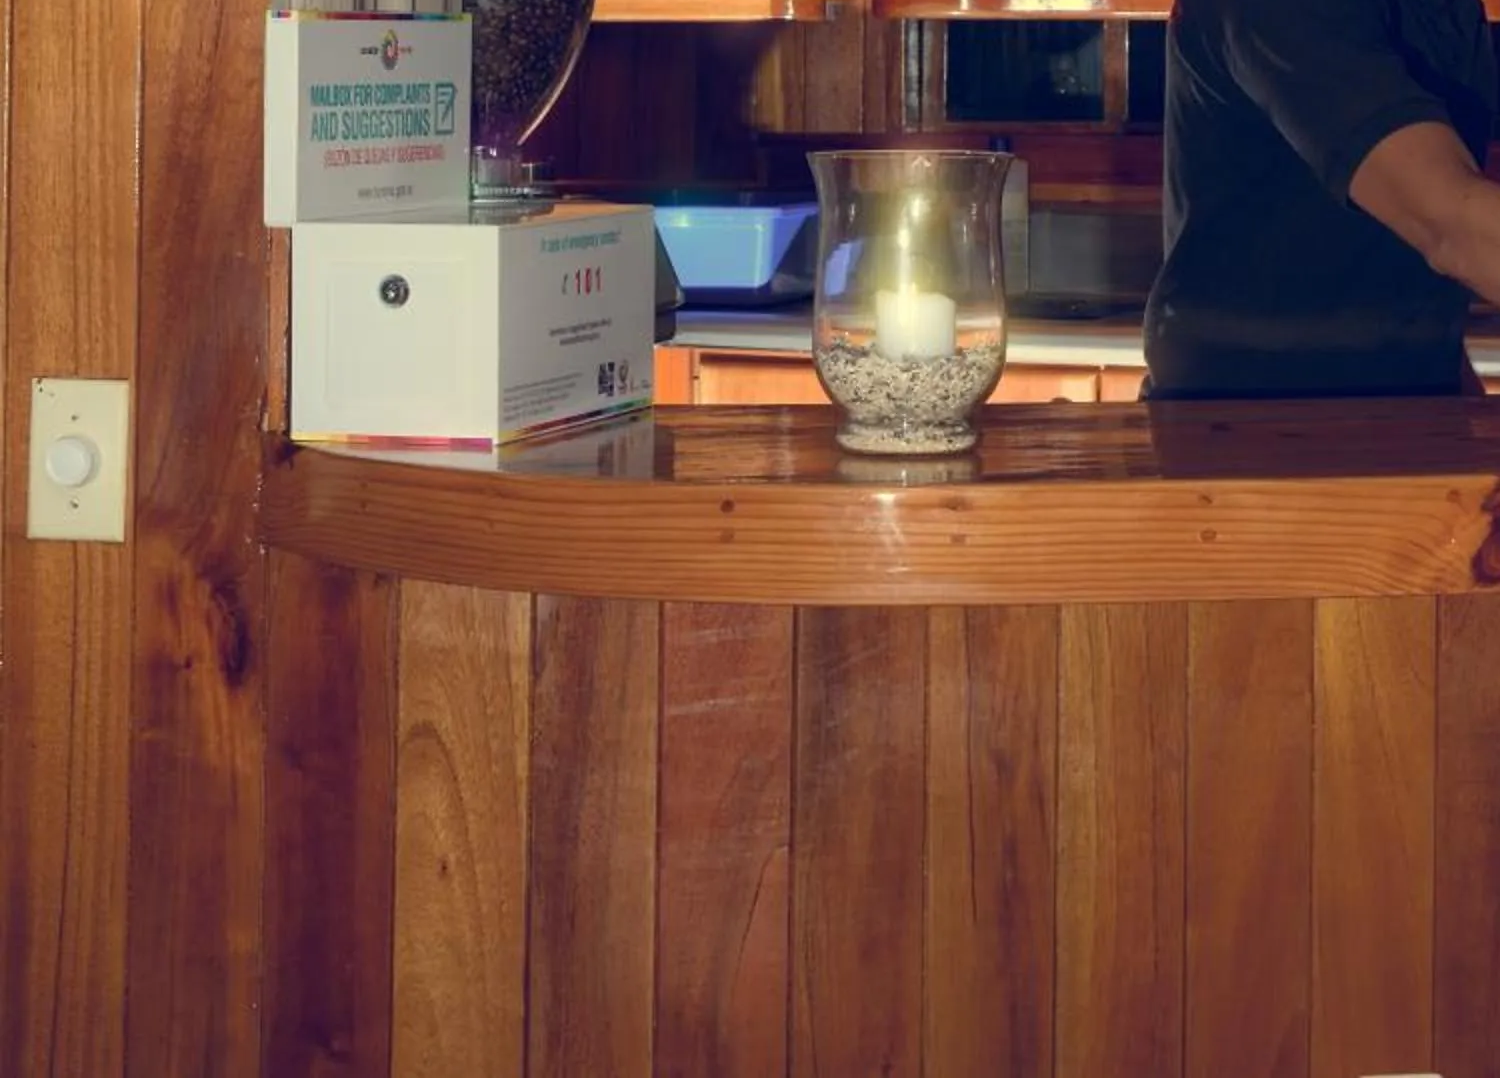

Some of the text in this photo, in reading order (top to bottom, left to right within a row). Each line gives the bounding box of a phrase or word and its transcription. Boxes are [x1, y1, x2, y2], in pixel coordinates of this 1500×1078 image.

[311, 83, 431, 106] MAILBOX FOR COMPLAINTS
[311, 108, 431, 141] AND SUGGESTIONS
[575, 267, 603, 296] 101
